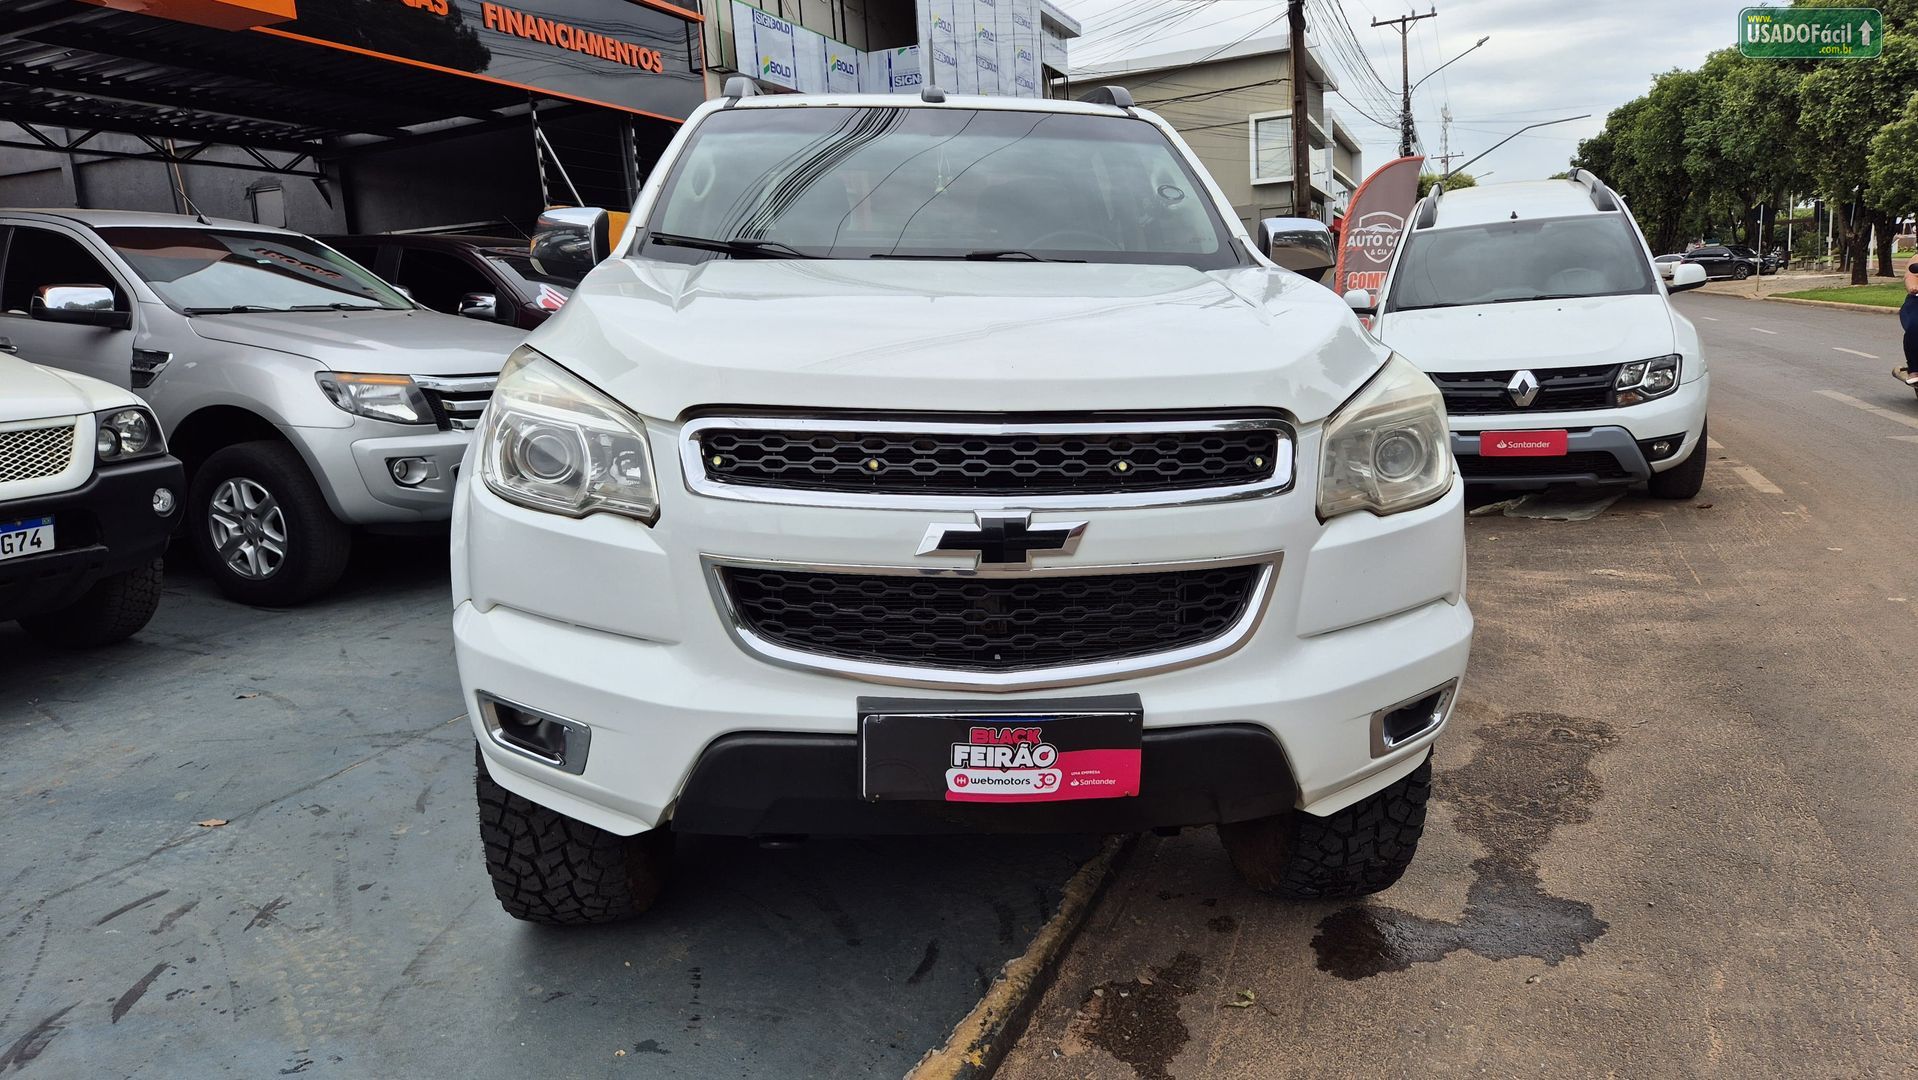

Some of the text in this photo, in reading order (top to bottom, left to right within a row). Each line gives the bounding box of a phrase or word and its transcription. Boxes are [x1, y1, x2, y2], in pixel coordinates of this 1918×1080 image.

[756, 11, 789, 34] SIGNBOLD
[482, 2, 664, 73] FINANCIAMENTOS
[770, 61, 791, 78] BOLD
[836, 59, 855, 75] BOLD
[1347, 235, 1383, 247] AUTO
[1508, 440, 1550, 449] Santander
[1, 529, 42, 555] G74
[971, 727, 1041, 744] BLACK
[953, 743, 1057, 768] FEIRÃO
[970, 773, 1057, 789] webmotors 30
[1079, 778, 1116, 786] Santander
